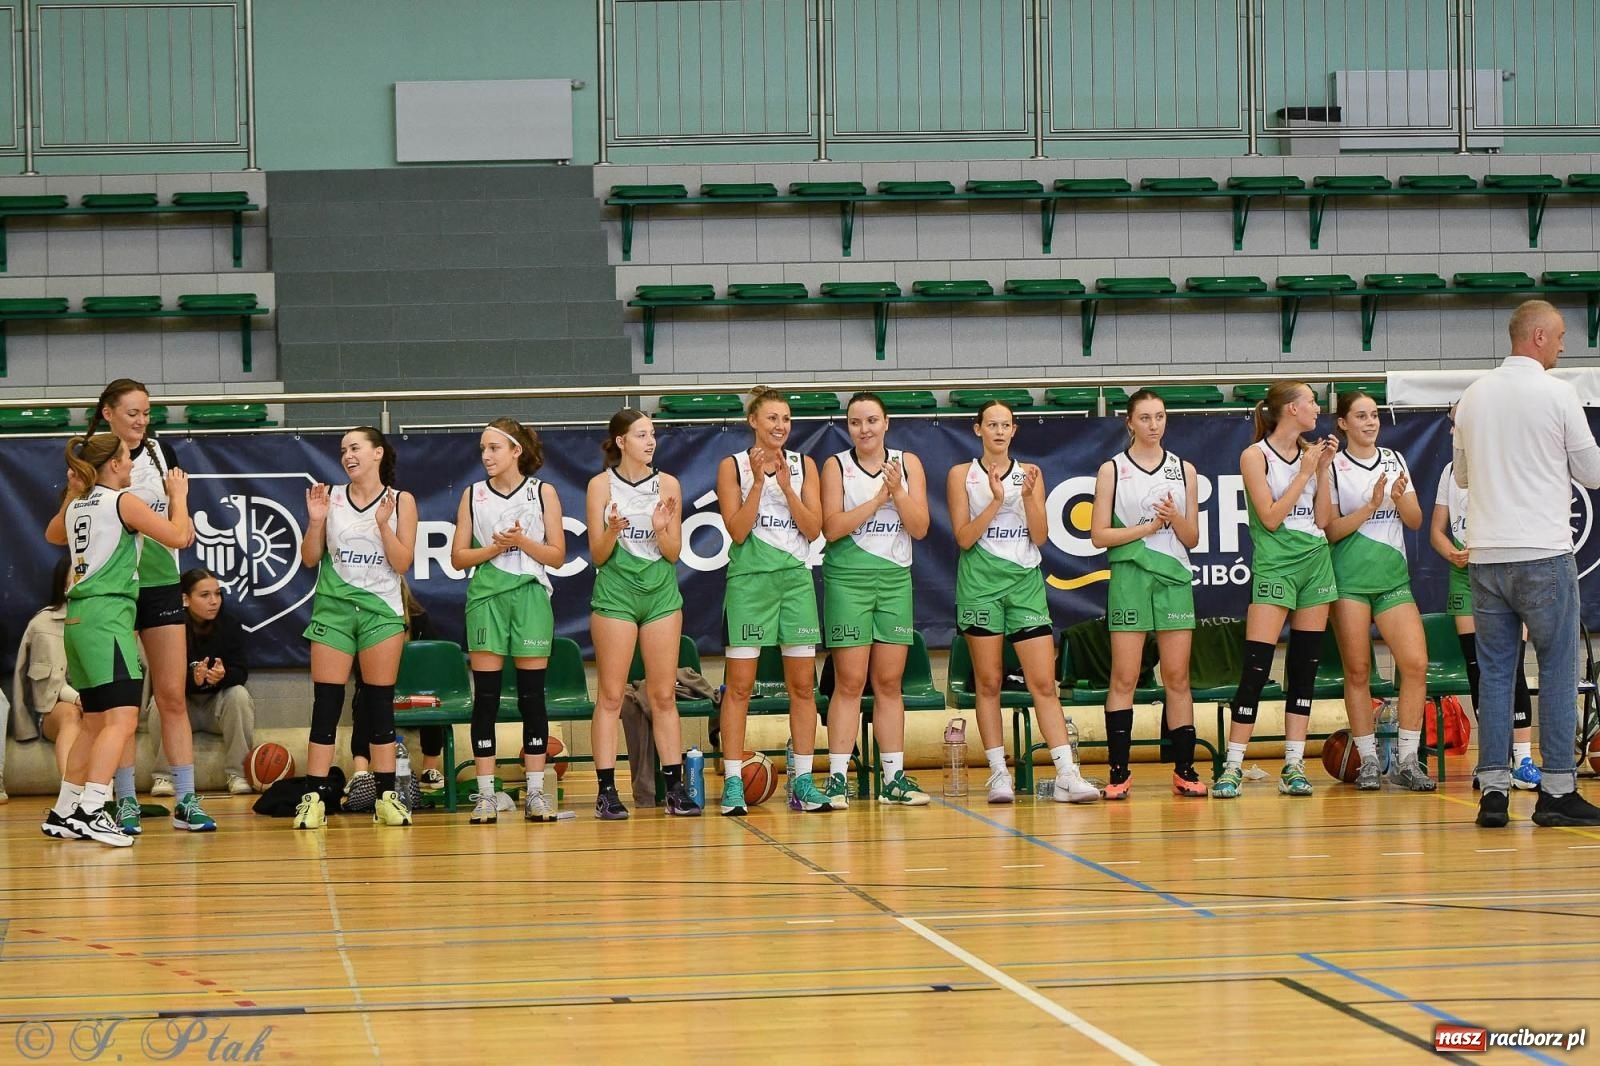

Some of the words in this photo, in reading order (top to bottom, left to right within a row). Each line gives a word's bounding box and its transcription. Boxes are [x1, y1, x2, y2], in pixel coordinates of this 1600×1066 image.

[760, 515, 798, 529] Clavis
[1367, 508, 1400, 520] lavis
[74, 515, 92, 554] 3
[987, 525, 1029, 538] Clavis
[341, 551, 384, 565] Clavis
[1257, 582, 1285, 599] 30
[962, 609, 990, 626] 26
[1112, 609, 1139, 626] 28
[477, 627, 487, 645] 11
[742, 624, 765, 641] 14
[831, 624, 861, 642] 24
